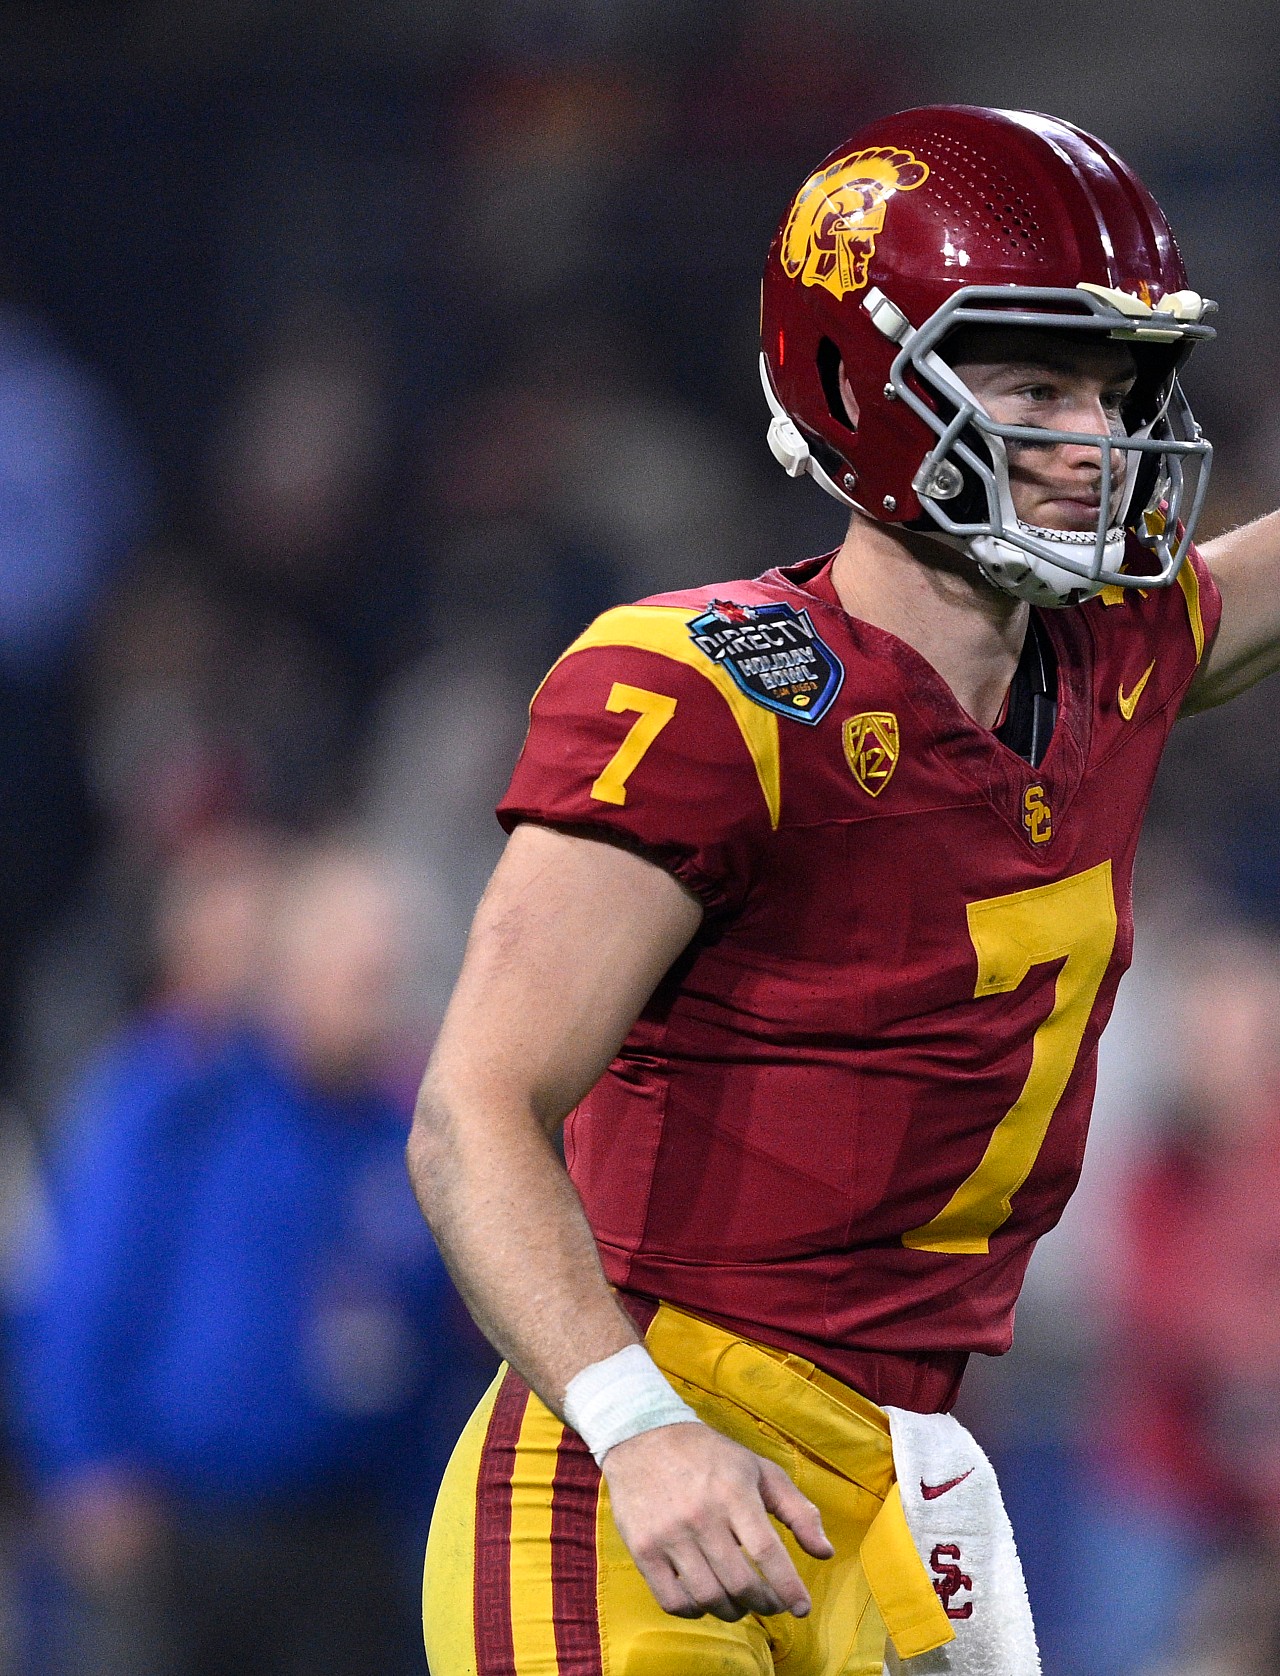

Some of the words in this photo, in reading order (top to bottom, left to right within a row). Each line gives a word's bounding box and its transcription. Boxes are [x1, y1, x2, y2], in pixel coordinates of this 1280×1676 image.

[694, 614, 814, 659] DIRECTV
[737, 646, 817, 677] HOLIDAY
[759, 665, 819, 690] BOWL
[590, 681, 678, 806] 7
[859, 747, 888, 780] 12
[1025, 786, 1051, 843] SC
[901, 858, 1118, 1255] 7
